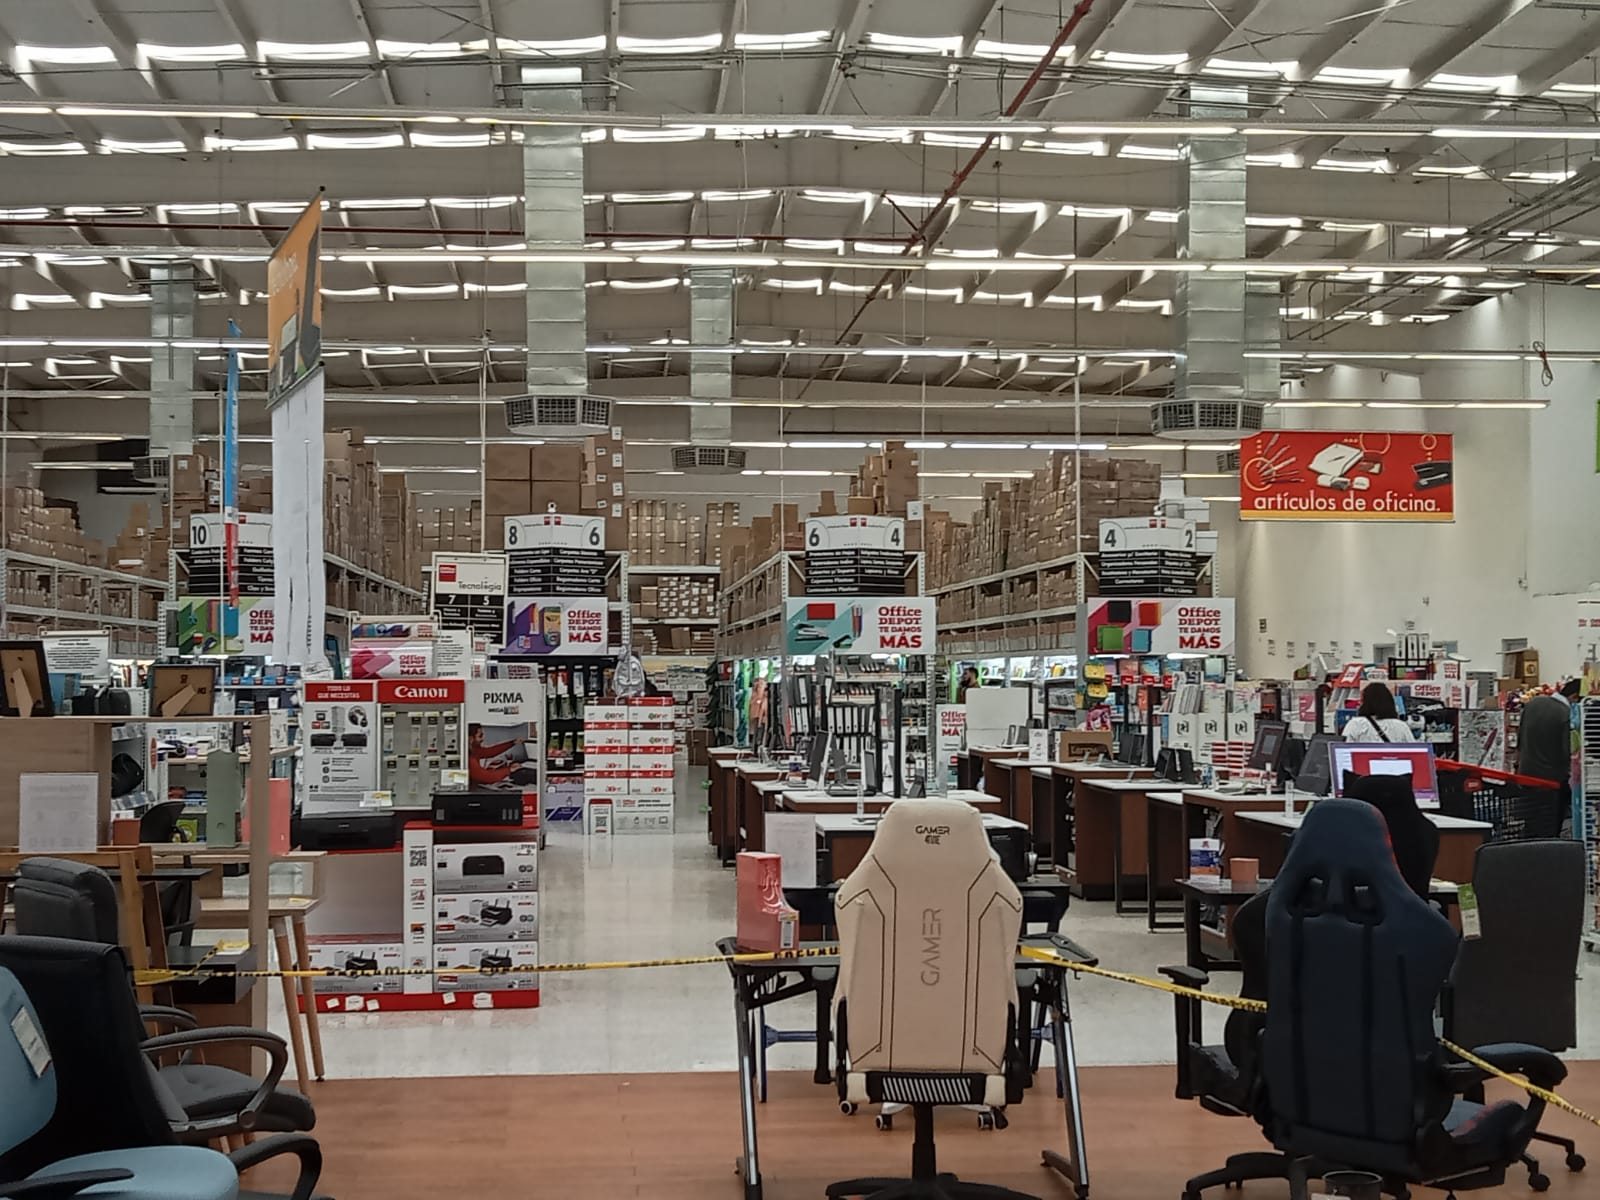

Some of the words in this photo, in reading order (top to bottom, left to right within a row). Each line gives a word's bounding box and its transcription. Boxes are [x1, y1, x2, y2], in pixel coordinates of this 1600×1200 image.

[1254, 489, 1336, 510] artículos
[1342, 490, 1366, 511] de
[192, 525, 206, 545] 10
[509, 526, 518, 545] 8
[589, 527, 600, 545] 6
[809, 528, 820, 546] 6
[891, 528, 900, 546] 4
[1104, 529, 1116, 547] 4
[1185, 530, 1193, 547] 2
[448, 594, 456, 605] 7
[483, 595, 490, 606] 5
[568, 610, 602, 618] Office
[878, 606, 922, 616] Office
[1178, 607, 1221, 617] Office
[1178, 618, 1221, 626] DEPOT
[250, 630, 274, 643] MÁ
[569, 630, 602, 643] MÁS
[880, 632, 922, 648] MÁS
[1179, 633, 1221, 649] MÁS
[394, 686, 448, 698] Canon
[483, 692, 524, 704] PIXMA
[915, 825, 950, 834] GAMER
[921, 908, 942, 986] GAMER
